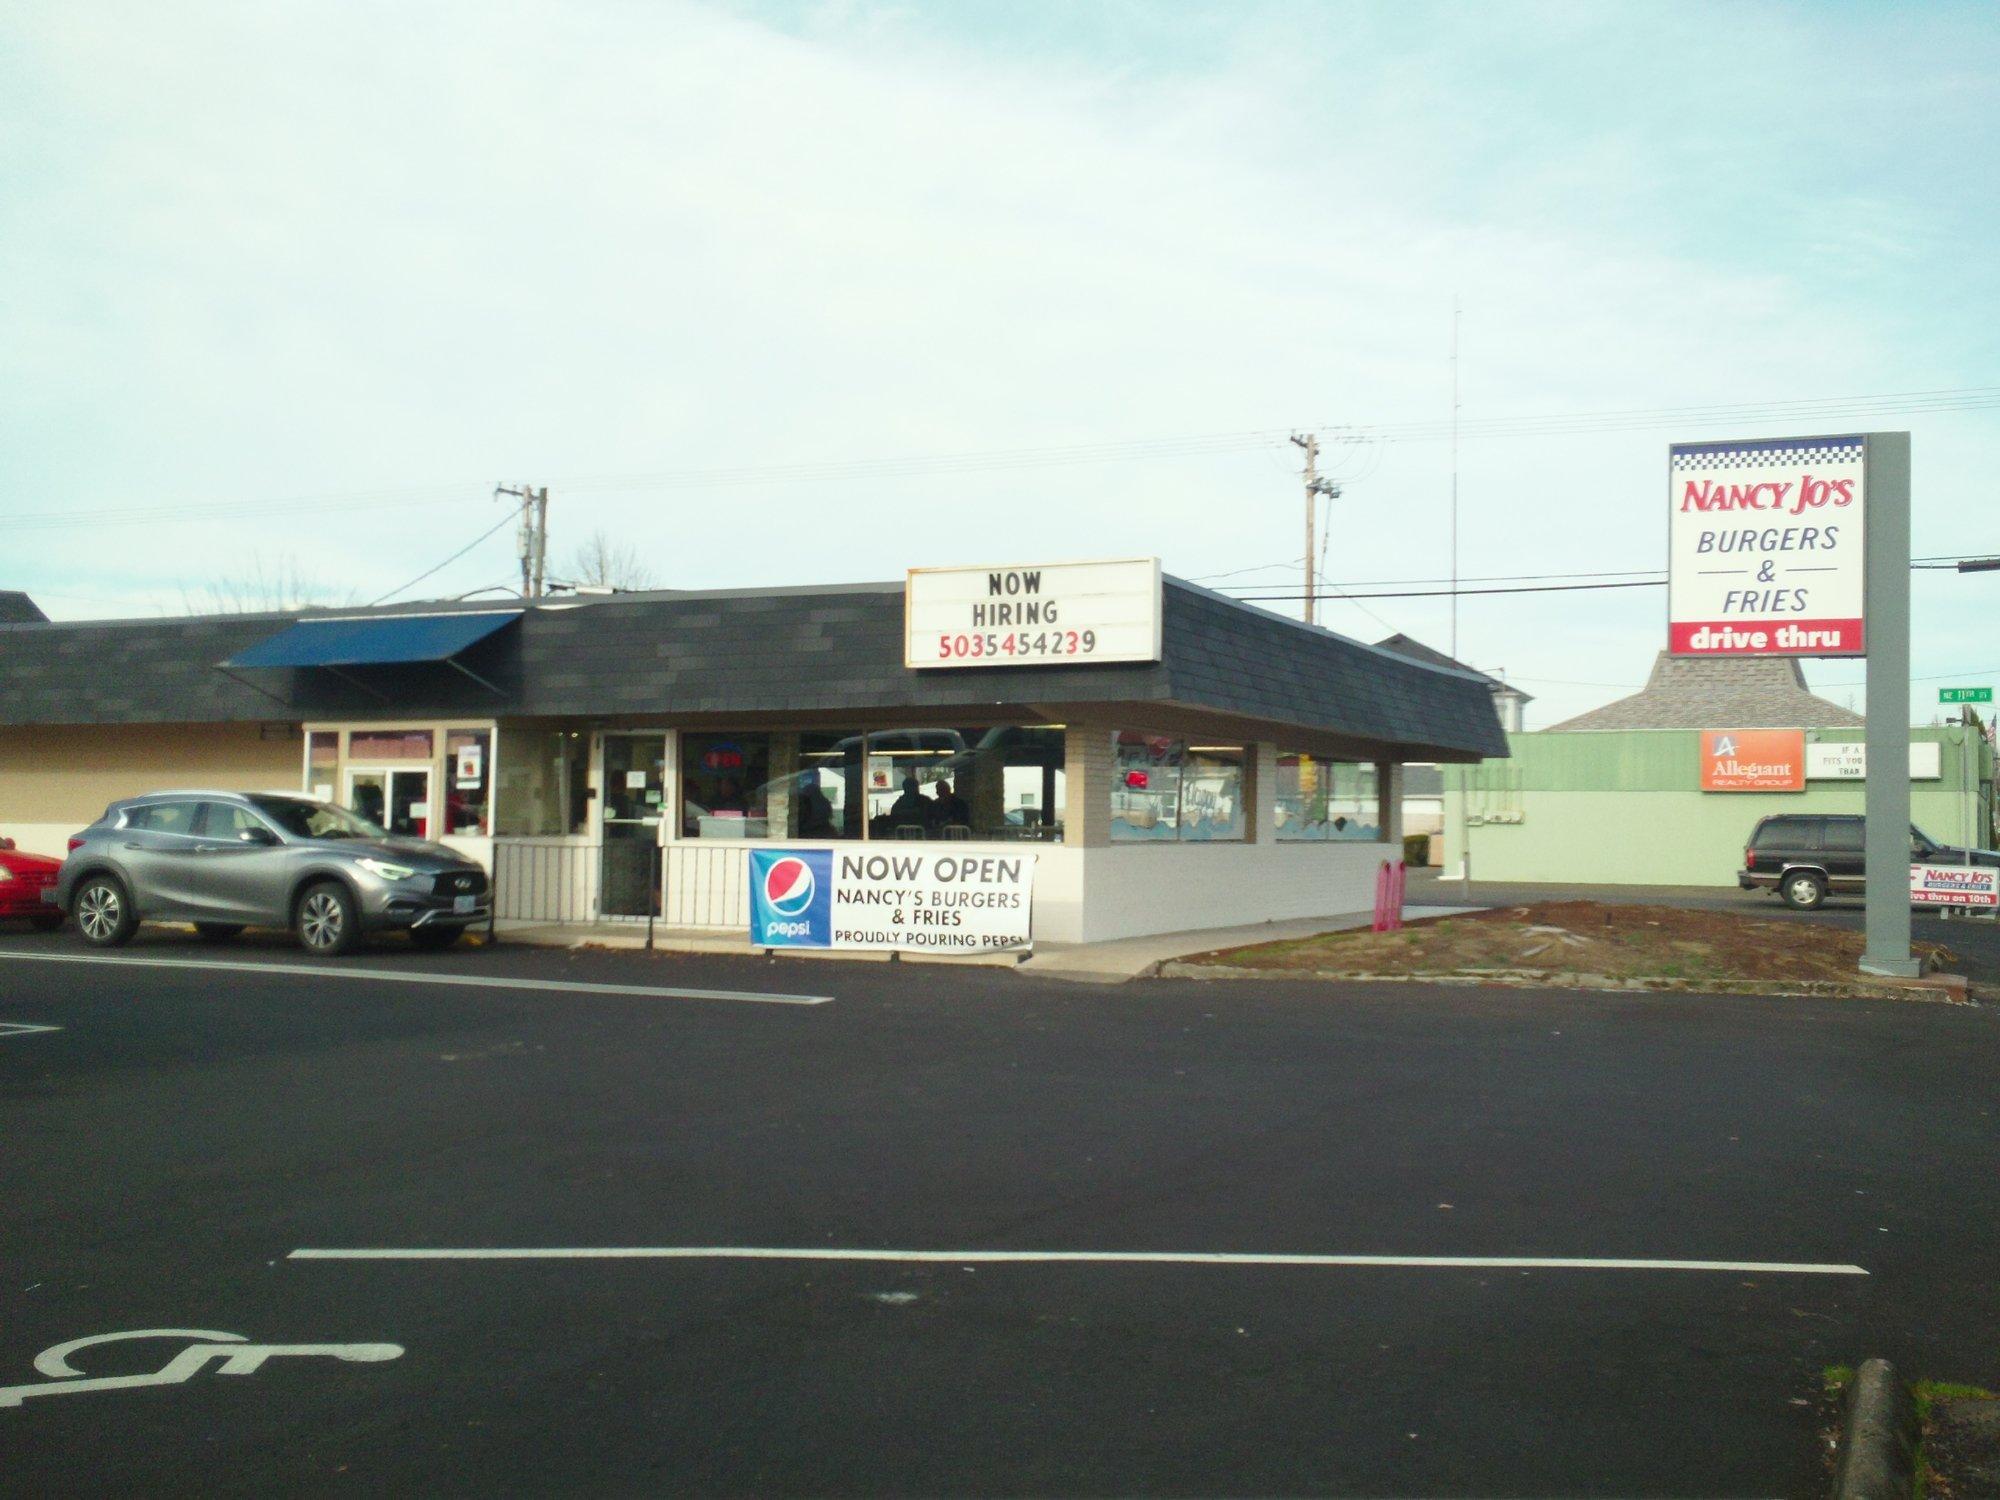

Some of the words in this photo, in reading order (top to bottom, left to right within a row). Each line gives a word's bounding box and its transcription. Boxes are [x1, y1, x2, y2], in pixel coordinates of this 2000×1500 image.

[1680, 480, 1793, 512] NANCY
[1790, 475, 1855, 515] JO'S
[1697, 526, 1840, 553] BURGERS
[1757, 560, 1775, 582] &
[989, 571, 1041, 596] NOW
[1723, 588, 1809, 613] FRIES
[973, 600, 1058, 627] HIRING
[939, 630, 1096, 658] 5035454239
[1690, 626, 1768, 649] drive
[1775, 624, 1840, 647] thru
[1712, 760, 1792, 779] Allegiant
[841, 856, 923, 882] NOW
[934, 857, 1021, 883] OPEN
[1924, 869, 1969, 882] NANCY
[837, 889, 923, 906] NANCY'S
[931, 890, 1020, 909] BURGERS
[1911, 891, 1925, 900] ive
[1927, 892, 1950, 901] thru
[1968, 894, 1991, 904] 10th
[766, 921, 811, 938] pepsi
[892, 910, 904, 924] &
[914, 910, 962, 926] FRIES
[835, 930, 900, 944] PROUDLY
[907, 932, 976, 947] POURING
